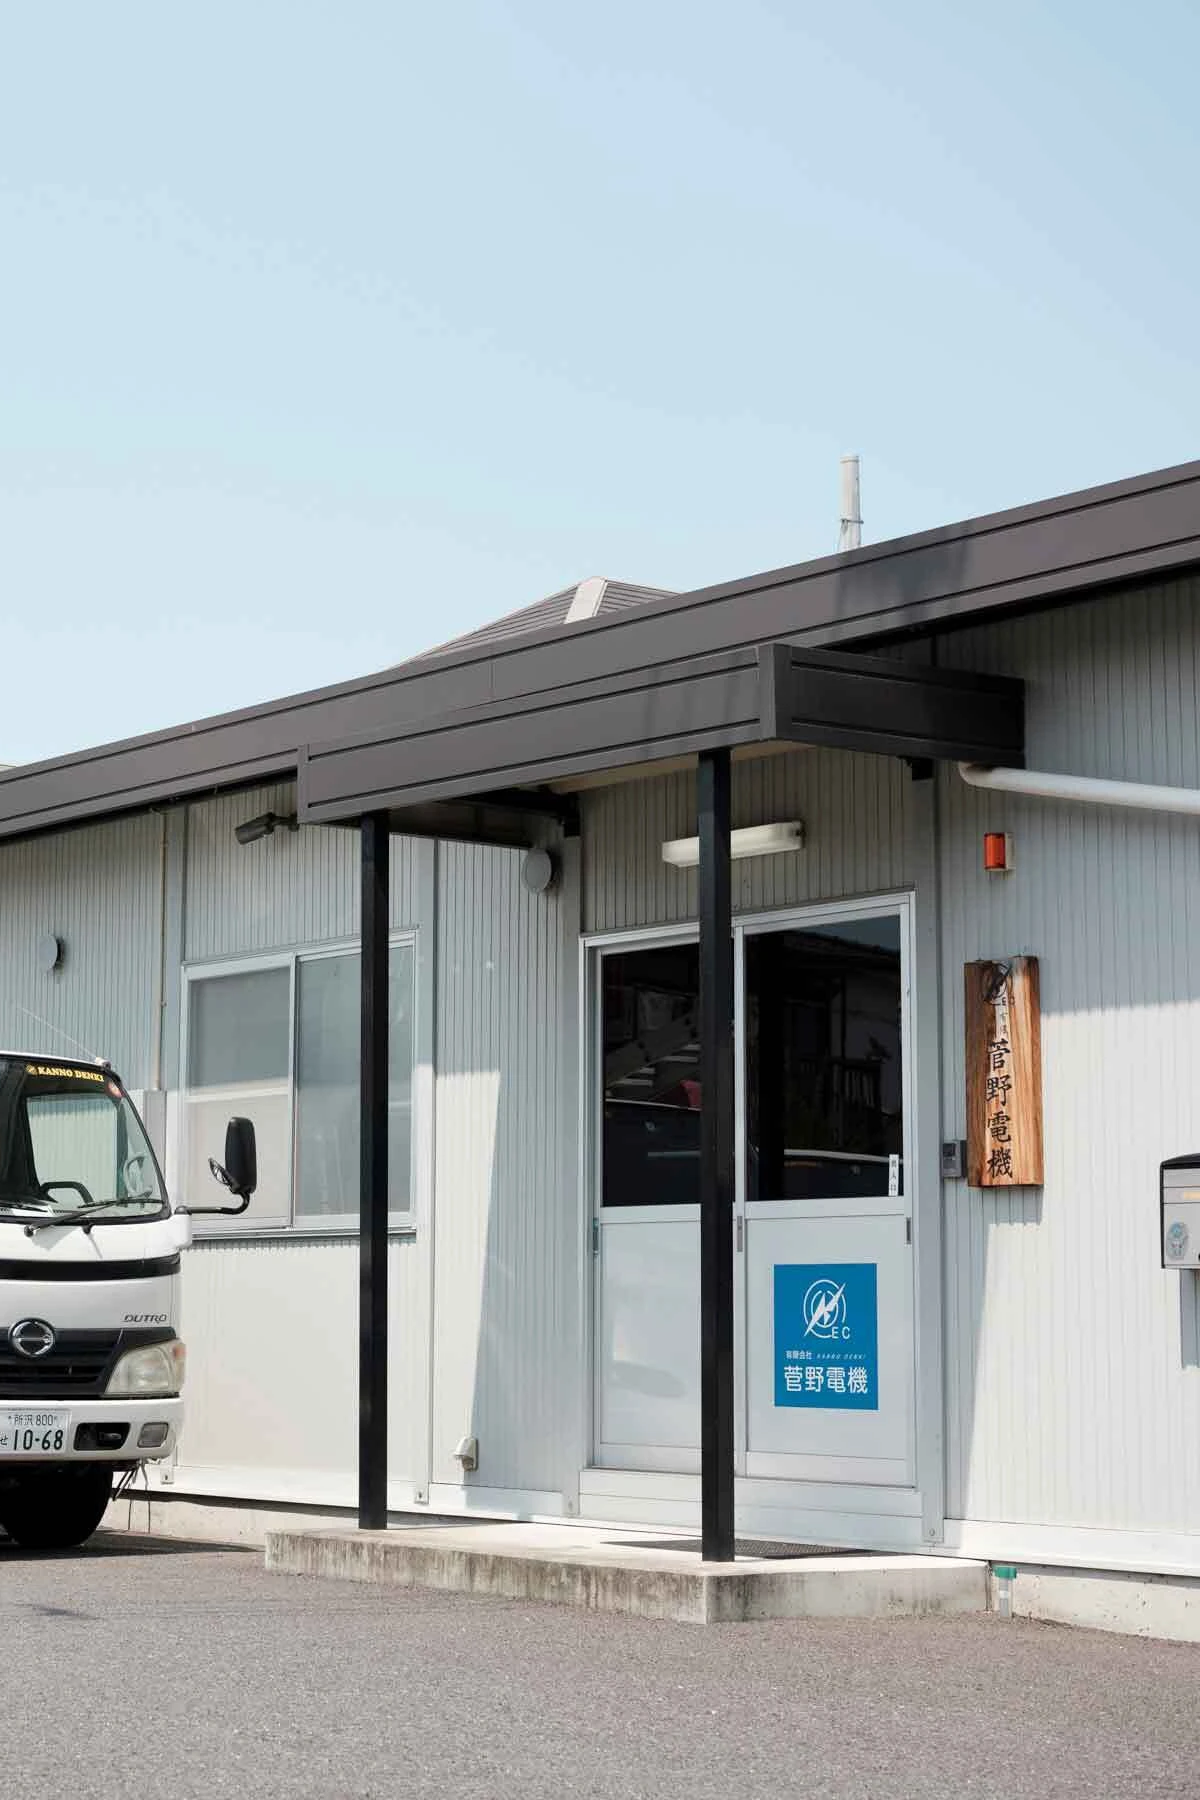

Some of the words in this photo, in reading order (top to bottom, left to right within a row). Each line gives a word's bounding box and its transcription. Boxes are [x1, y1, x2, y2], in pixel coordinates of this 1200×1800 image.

[37, 1066, 73, 1077] KANNO
[75, 1070, 105, 1082] DENKI
[986, 1038, 1013, 1179] 菅野電機
[123, 1313, 167, 1324] DUTRO
[784, 1365, 868, 1394] 菅野電機
[36, 1414, 53, 1426] 800
[13, 1429, 64, 1451] 10-68
